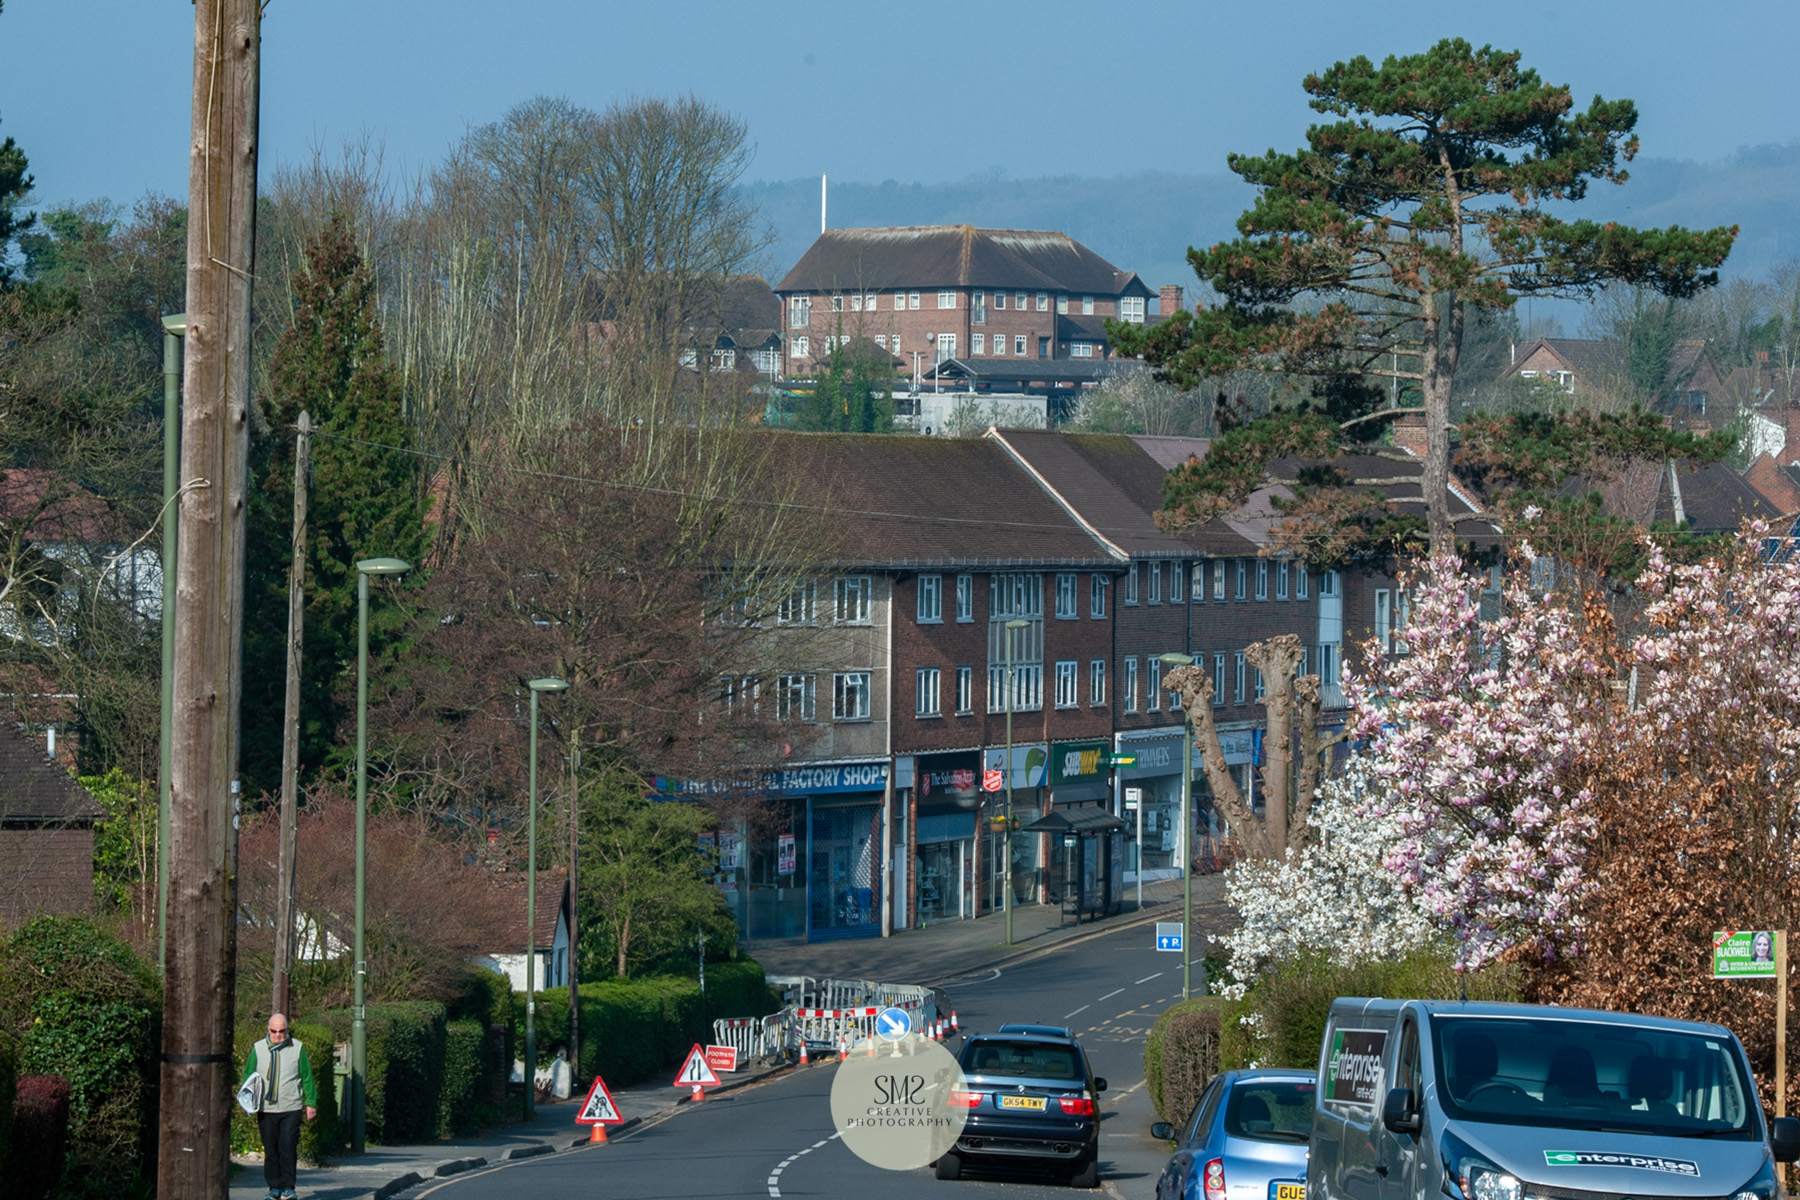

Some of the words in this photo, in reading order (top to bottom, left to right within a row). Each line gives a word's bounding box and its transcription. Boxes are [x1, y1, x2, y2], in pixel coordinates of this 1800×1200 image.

[1062, 747, 1102, 779] SUBWAY
[783, 767, 841, 790] FACTORY
[843, 765, 880, 787] SHOP
[931, 772, 940, 786] The
[1715, 932, 1731, 946] VOTE
[1717, 948, 1750, 957] BLACKWELL
[1329, 1044, 1381, 1092] enterprise
[1549, 1152, 1696, 1171] enterprise
